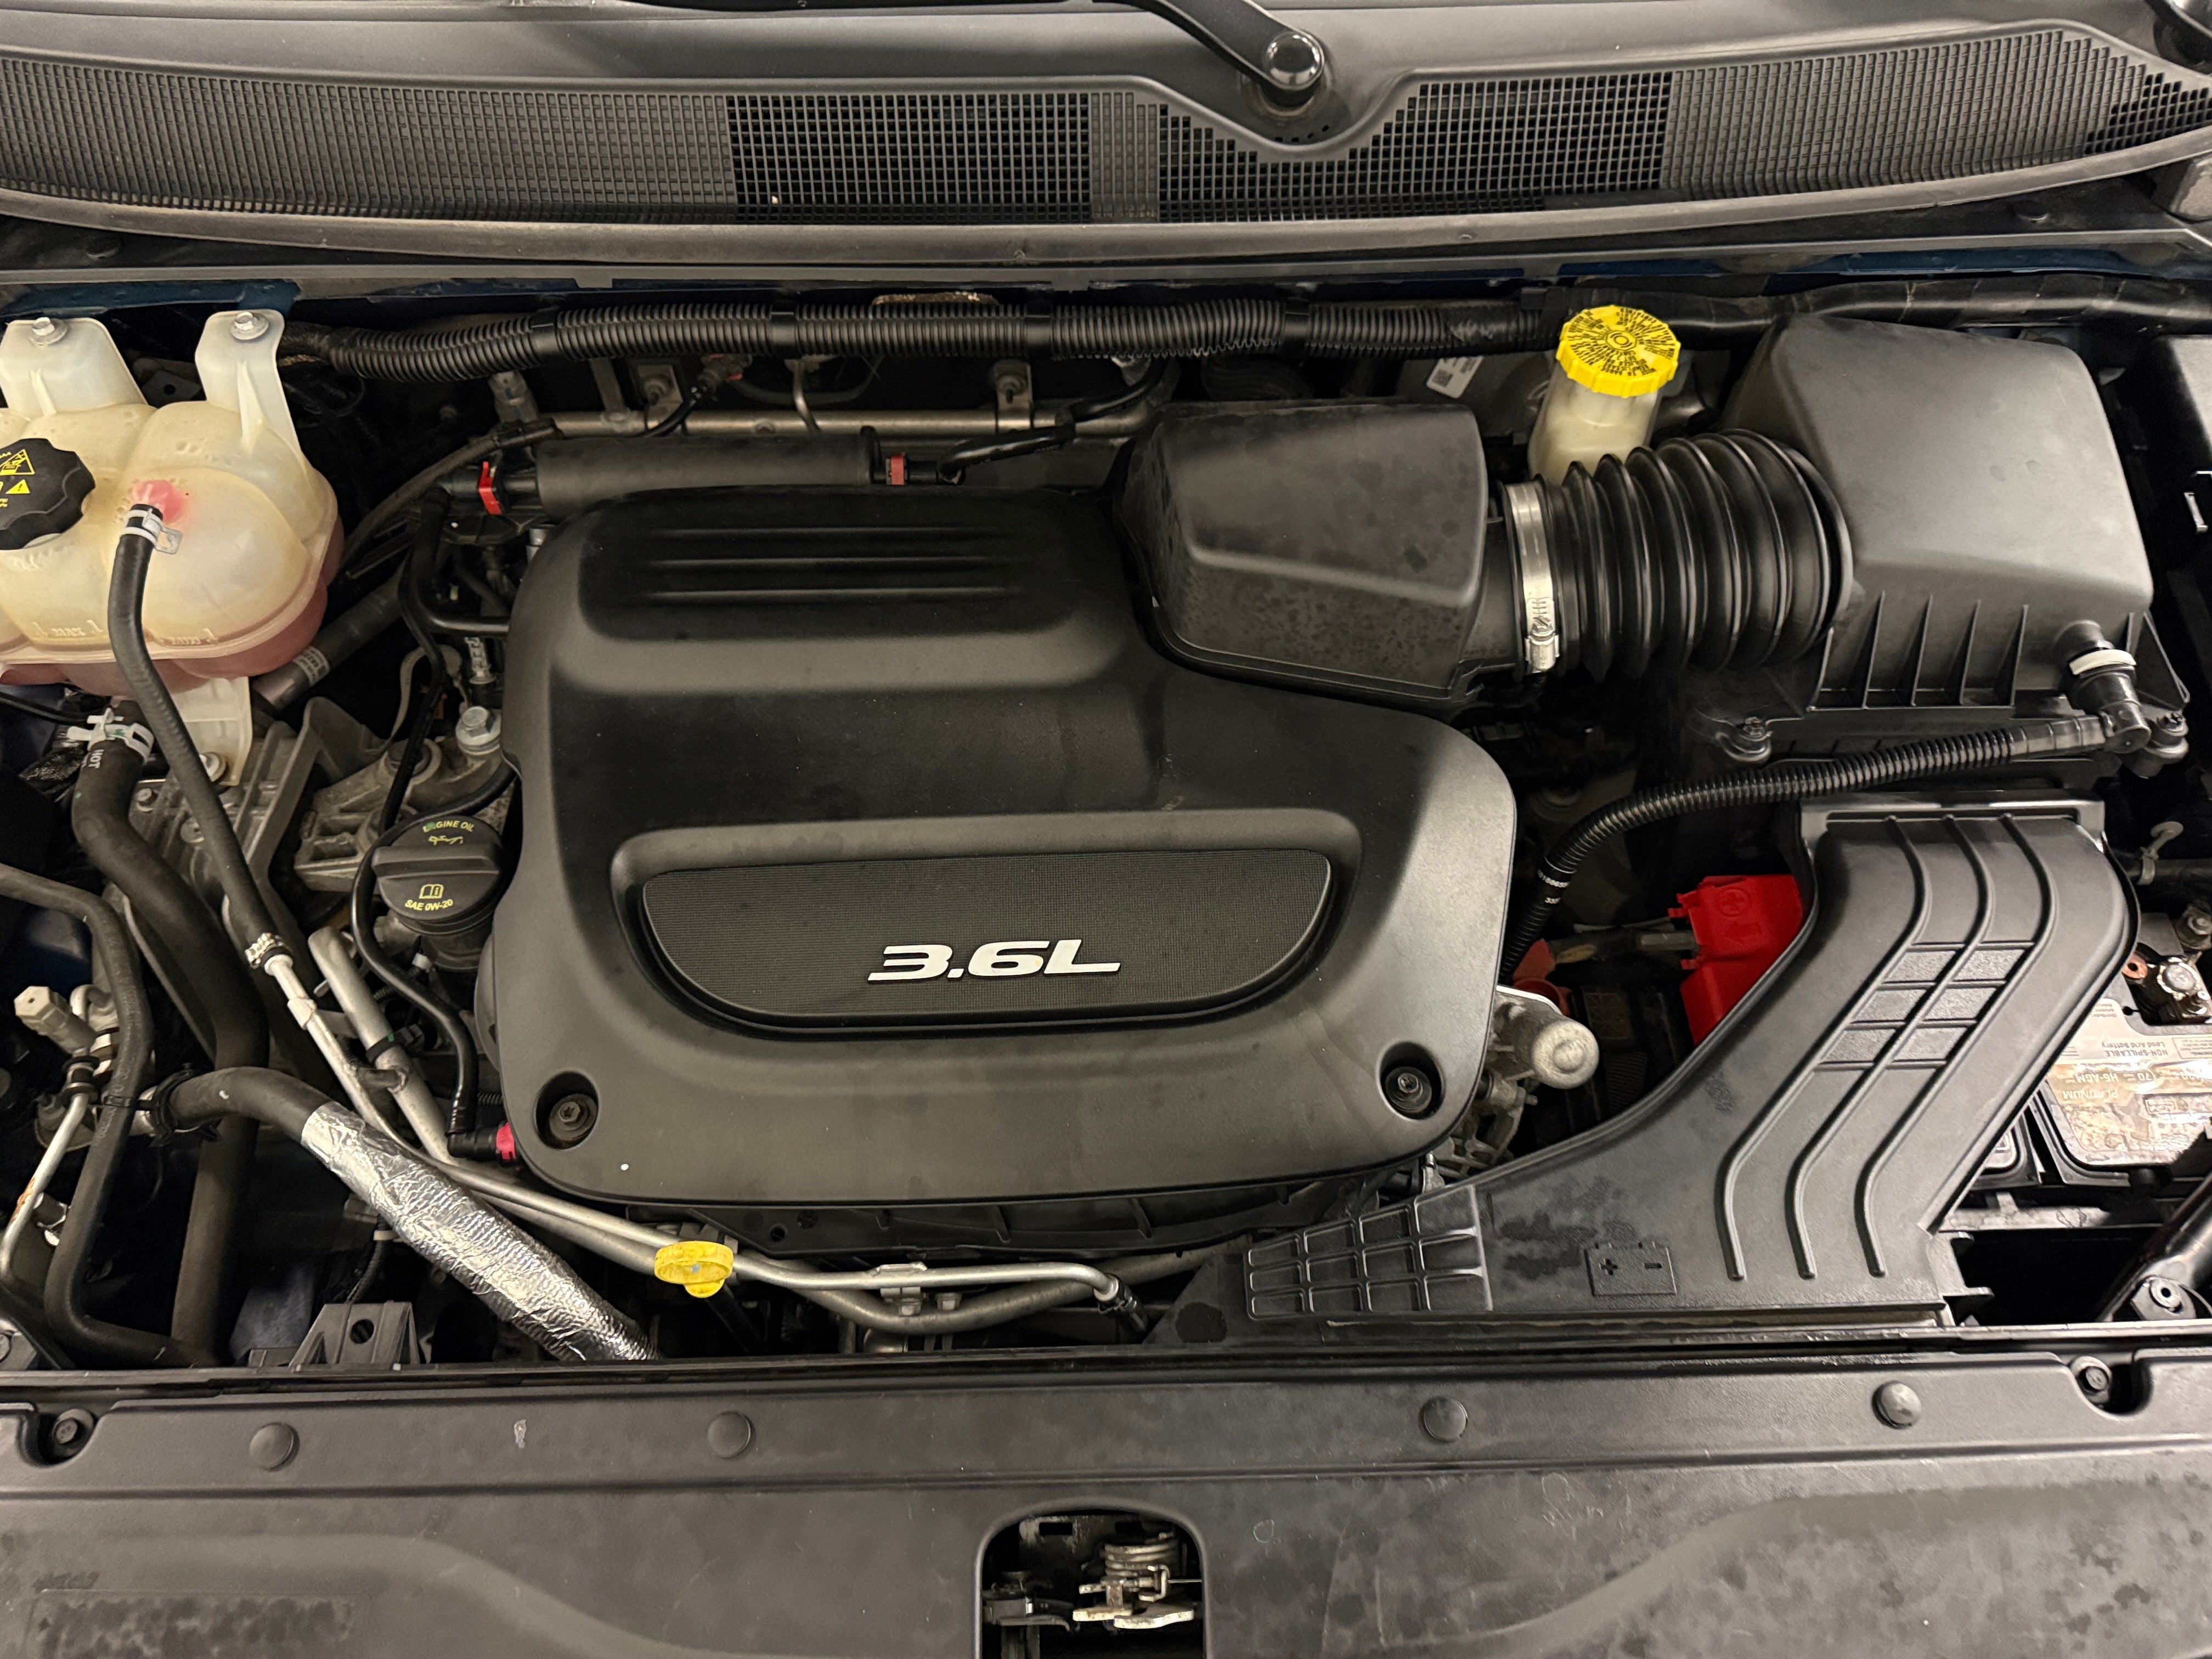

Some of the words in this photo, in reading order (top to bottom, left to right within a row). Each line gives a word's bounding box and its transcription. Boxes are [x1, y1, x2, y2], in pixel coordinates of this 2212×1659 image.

[88, 748, 105, 769] HOT
[422, 820, 460, 833] GINE
[460, 821, 475, 833] OIL
[404, 899, 425, 911] SAE
[425, 899, 454, 911] 0W-20
[867, 939, 1121, 982] 3.6L
[2104, 1048, 2169, 1057] NON-SPILLABLE
[2075, 1072, 2119, 1084] H6-AGM
[2137, 1072, 2153, 1082] 70
[2062, 1089, 2118, 1099] PLATINUM
